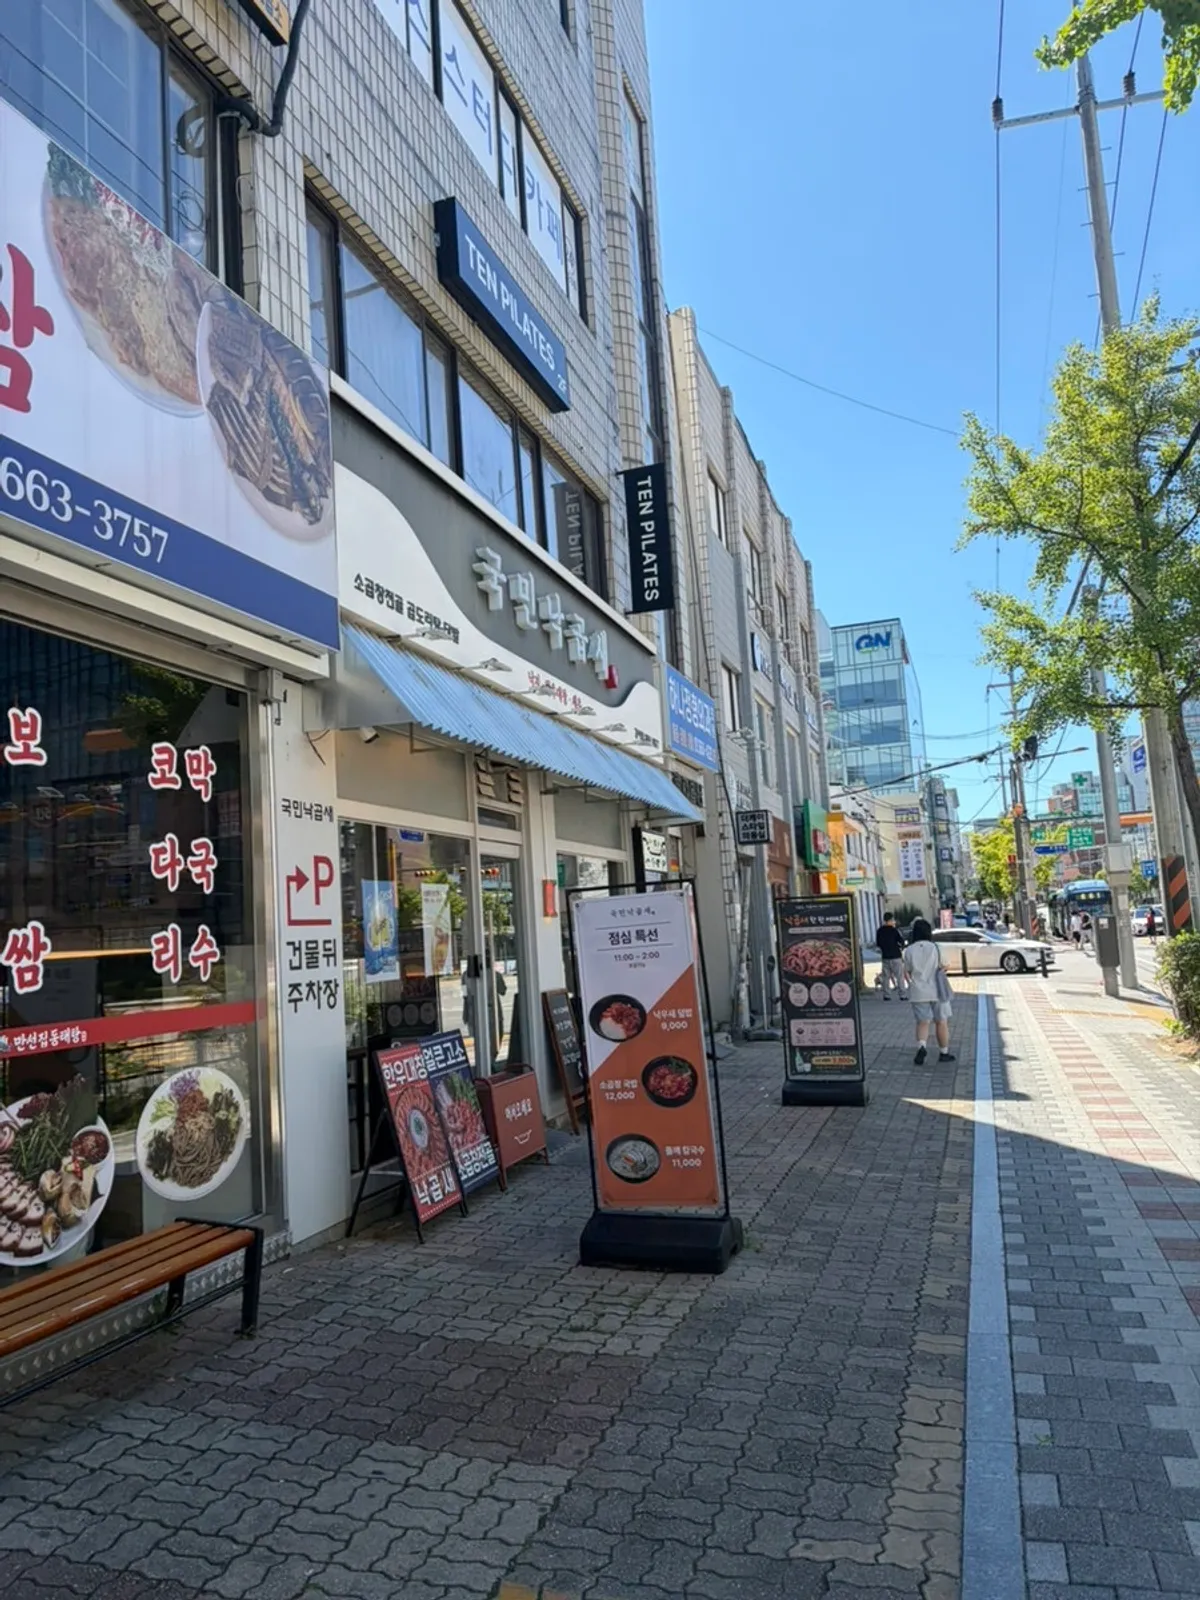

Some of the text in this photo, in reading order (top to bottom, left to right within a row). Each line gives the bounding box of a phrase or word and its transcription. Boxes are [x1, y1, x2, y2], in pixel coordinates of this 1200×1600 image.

[464, 233, 499, 300] TEN
[501, 285, 556, 371] PILATES
[0, 456, 170, 564] 663-3757
[637, 475, 660, 602] TEN PILATES
[855, 631, 892, 654] GN
[281, 798, 334, 823] 국민낙곱새
[313, 854, 335, 906] P
[608, 927, 659, 946] 점심 특선
[642, 950, 660, 960] 2:00
[287, 978, 340, 1014] 주차장
[605, 1092, 635, 1102] 12,000
[671, 1158, 702, 1169] 11,000
[413, 1167, 456, 1206] 낙곱새
